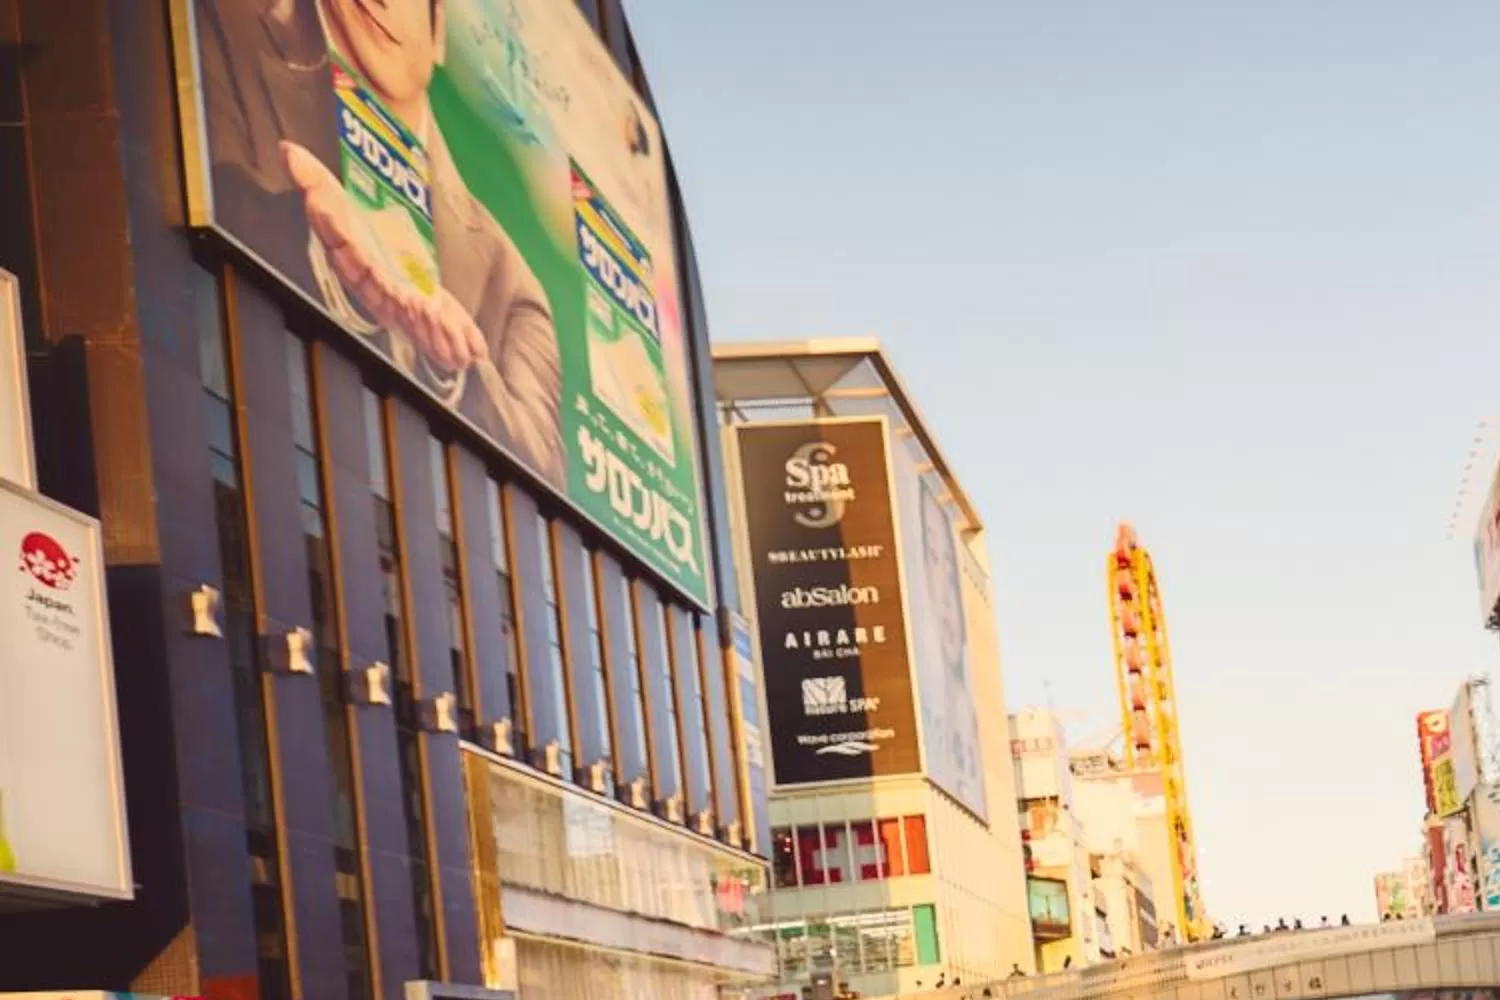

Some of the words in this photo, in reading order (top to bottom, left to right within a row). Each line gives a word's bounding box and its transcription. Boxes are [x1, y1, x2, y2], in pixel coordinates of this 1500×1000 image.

[341, 107, 431, 217] サロンパス
[579, 223, 660, 345] サロンパス
[578, 425, 701, 576] サロンパス
[785, 458, 851, 494] Spa
[781, 584, 880, 608] abSalon
